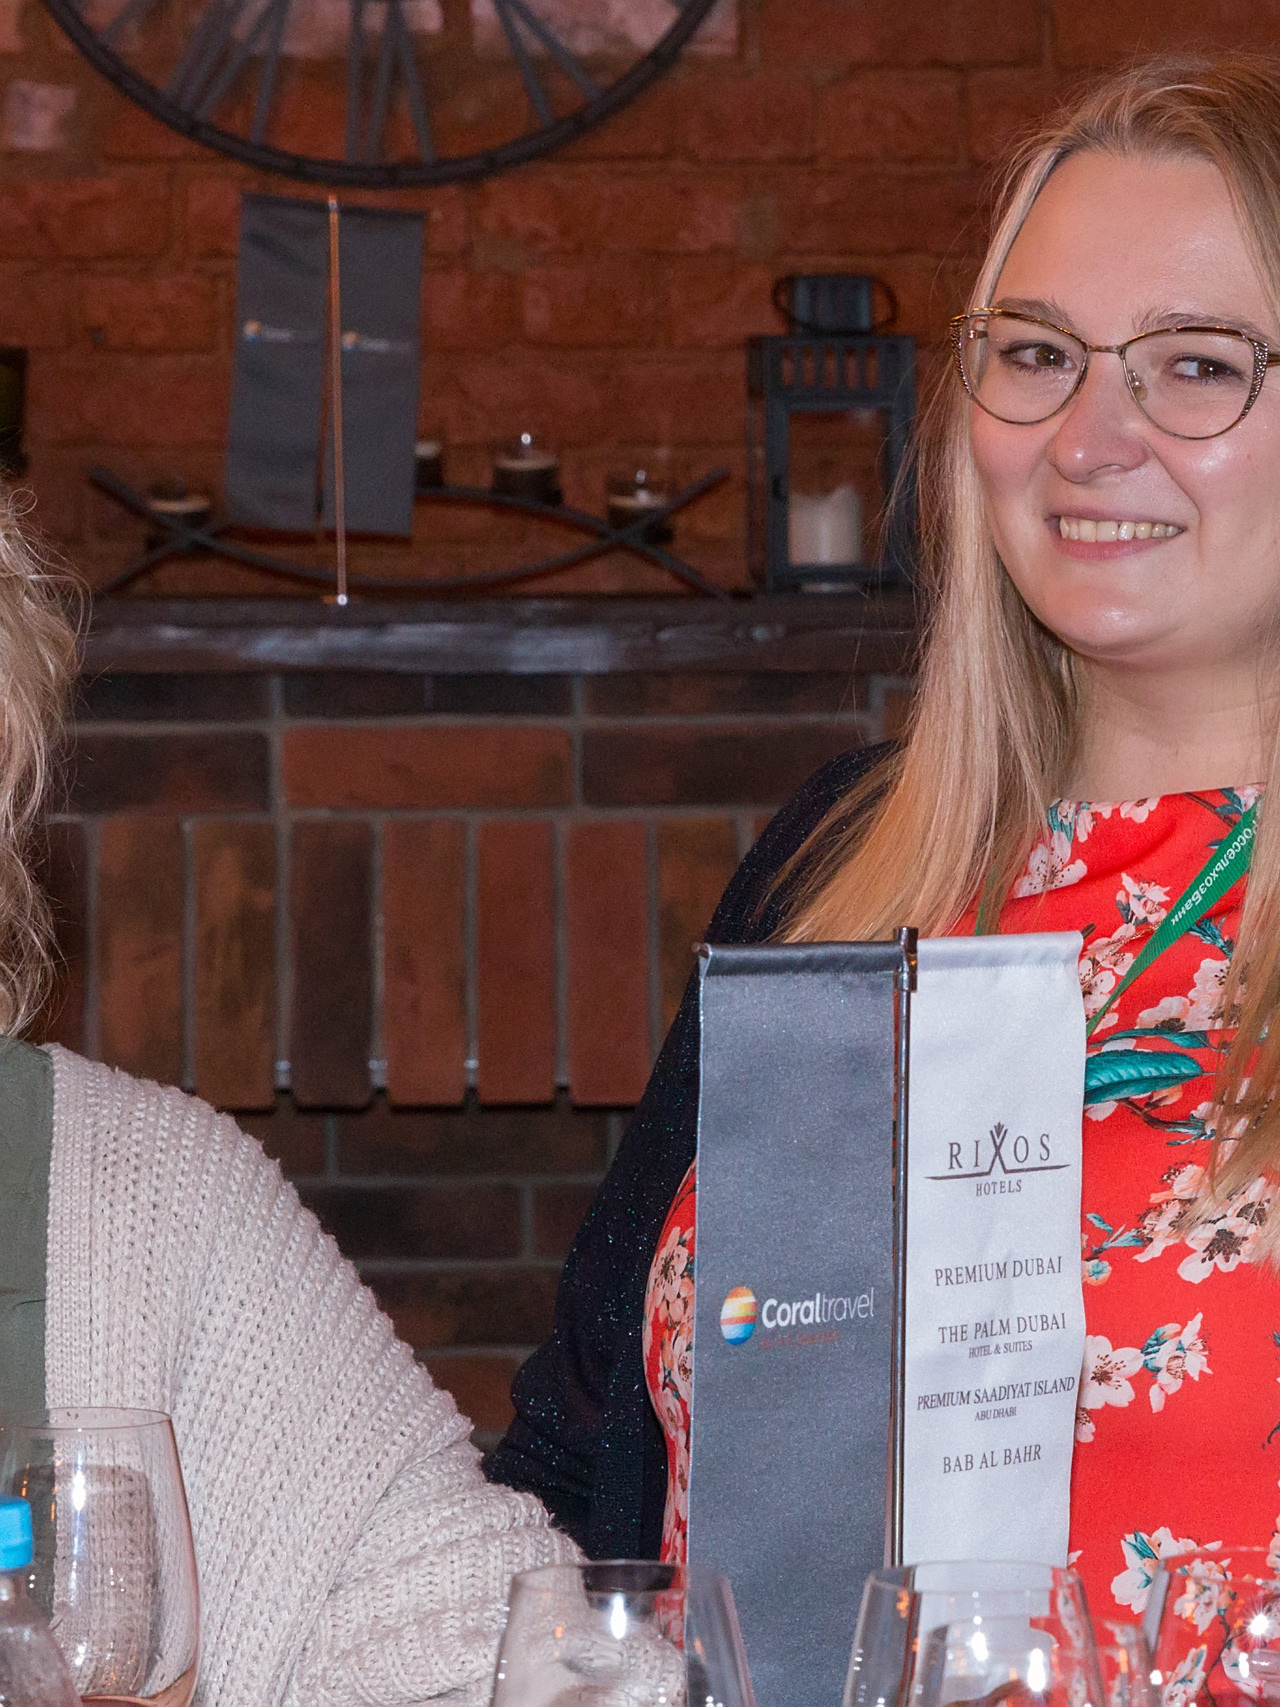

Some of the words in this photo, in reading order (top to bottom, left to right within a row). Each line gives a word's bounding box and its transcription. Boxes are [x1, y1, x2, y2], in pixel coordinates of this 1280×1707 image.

[948, 1122, 1050, 1174] RIXOS
[976, 1180, 1022, 1196] HOTELS
[935, 1261, 1007, 1286] PREMIUM
[1012, 1256, 1062, 1278] DUBAI
[938, 1325, 968, 1344] THE
[974, 1318, 1010, 1339] PALM
[1017, 1313, 1066, 1333] DUBAI
[968, 1344, 992, 1358] HOTEL
[994, 1344, 1001, 1354] &
[1003, 1340, 1033, 1353] SUITES
[917, 1390, 971, 1410] PREMIUM
[973, 1382, 1031, 1405] SAADIYAT
[1033, 1377, 1075, 1396] ISLAND
[974, 1408, 991, 1421] ABU
[993, 1406, 1017, 1419] DHABI
[943, 1454, 974, 1473] BAB
[979, 1451, 998, 1469] AL
[1003, 1444, 1042, 1465] BAHR
